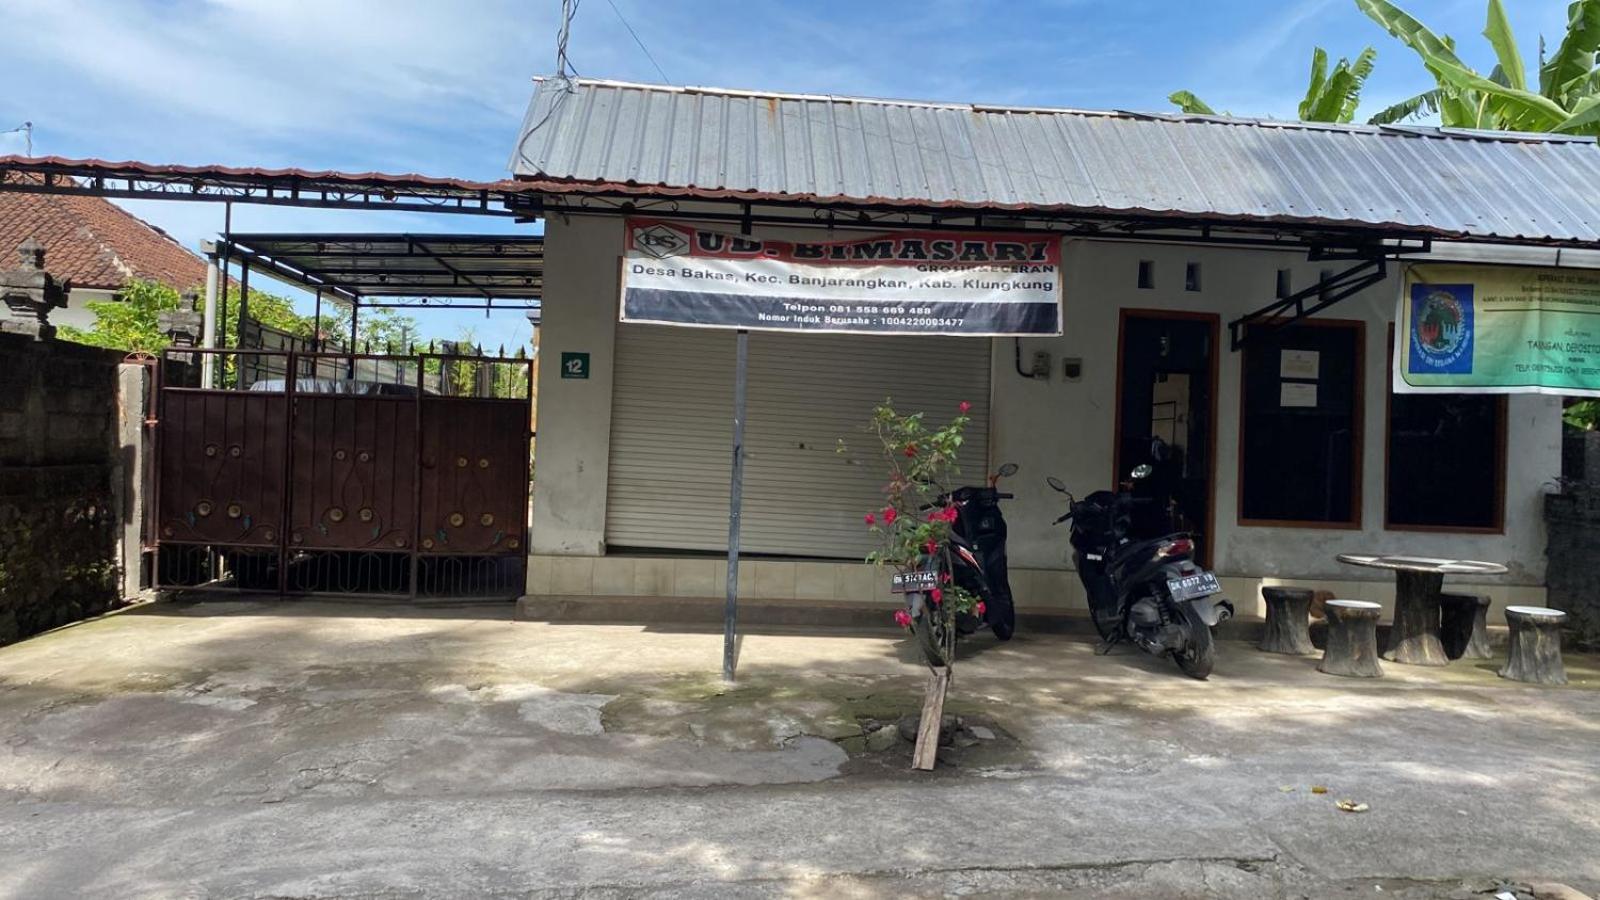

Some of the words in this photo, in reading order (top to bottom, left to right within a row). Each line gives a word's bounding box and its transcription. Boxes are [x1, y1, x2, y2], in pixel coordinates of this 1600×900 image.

[792, 239, 1048, 262] BIMASARI
[632, 263, 676, 278] Desa
[681, 267, 739, 282] Bakas,
[744, 272, 783, 284] Kec.
[788, 274, 913, 290] Banjarangkan,
[920, 279, 957, 289] Kab.
[963, 279, 1054, 292] Klungkung
[783, 302, 826, 313] Telpon
[829, 305, 852, 314] 081
[855, 306, 879, 314] 558
[908, 307, 932, 315] 488
[758, 312, 791, 322] Nomor
[793, 314, 821, 324] Induk
[824, 315, 870, 326] Berusaha
[565, 359, 583, 373] 12
